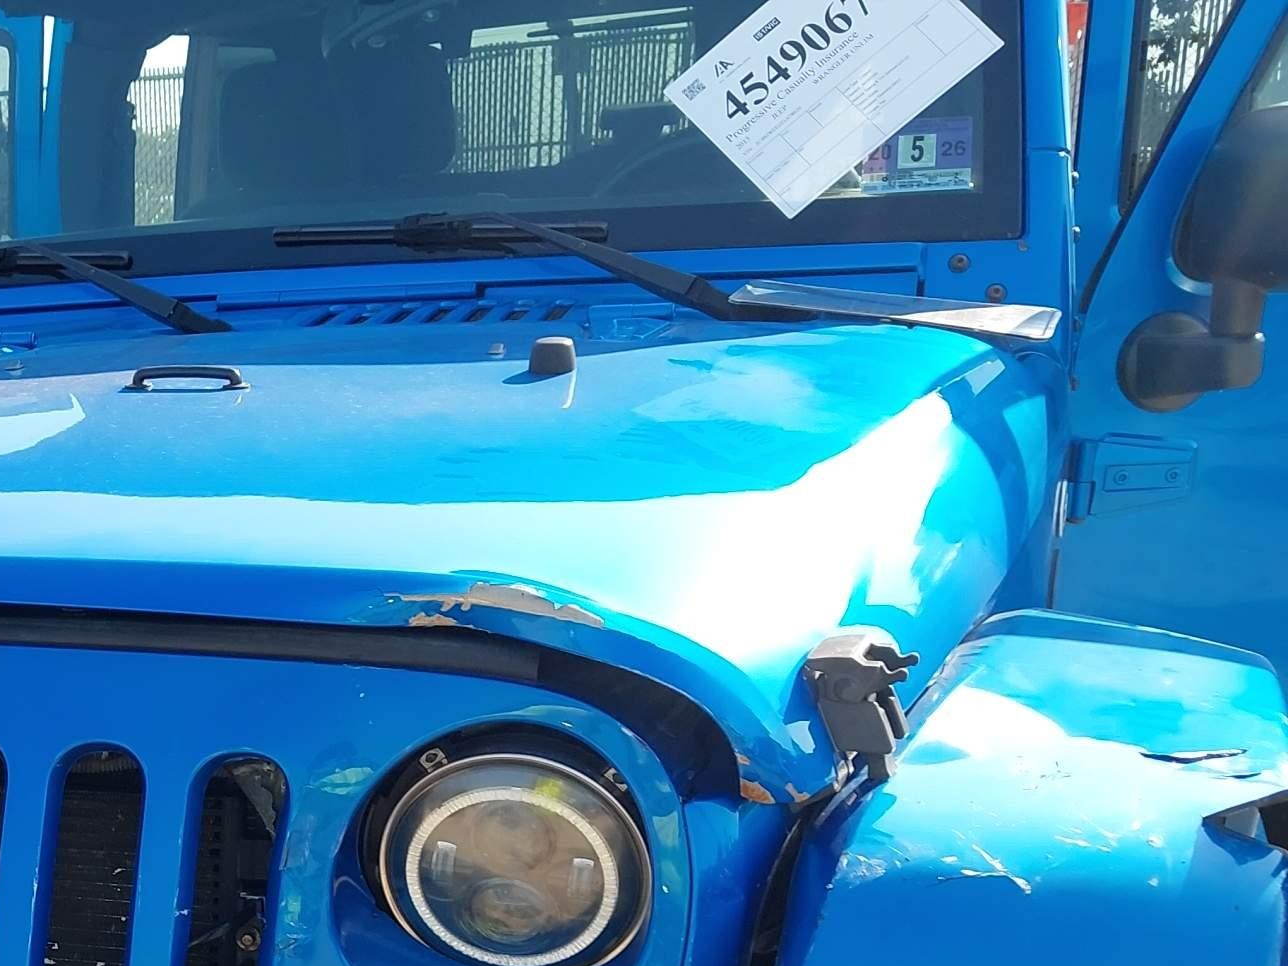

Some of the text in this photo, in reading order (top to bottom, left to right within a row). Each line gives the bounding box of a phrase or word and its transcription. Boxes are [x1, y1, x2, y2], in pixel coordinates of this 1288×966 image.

[725, 98, 777, 142] Progressive
[776, 69, 816, 100] Casualty
[814, 31, 859, 68] Insurance
[910, 135, 925, 162] 5
[941, 140, 967, 157] 26
